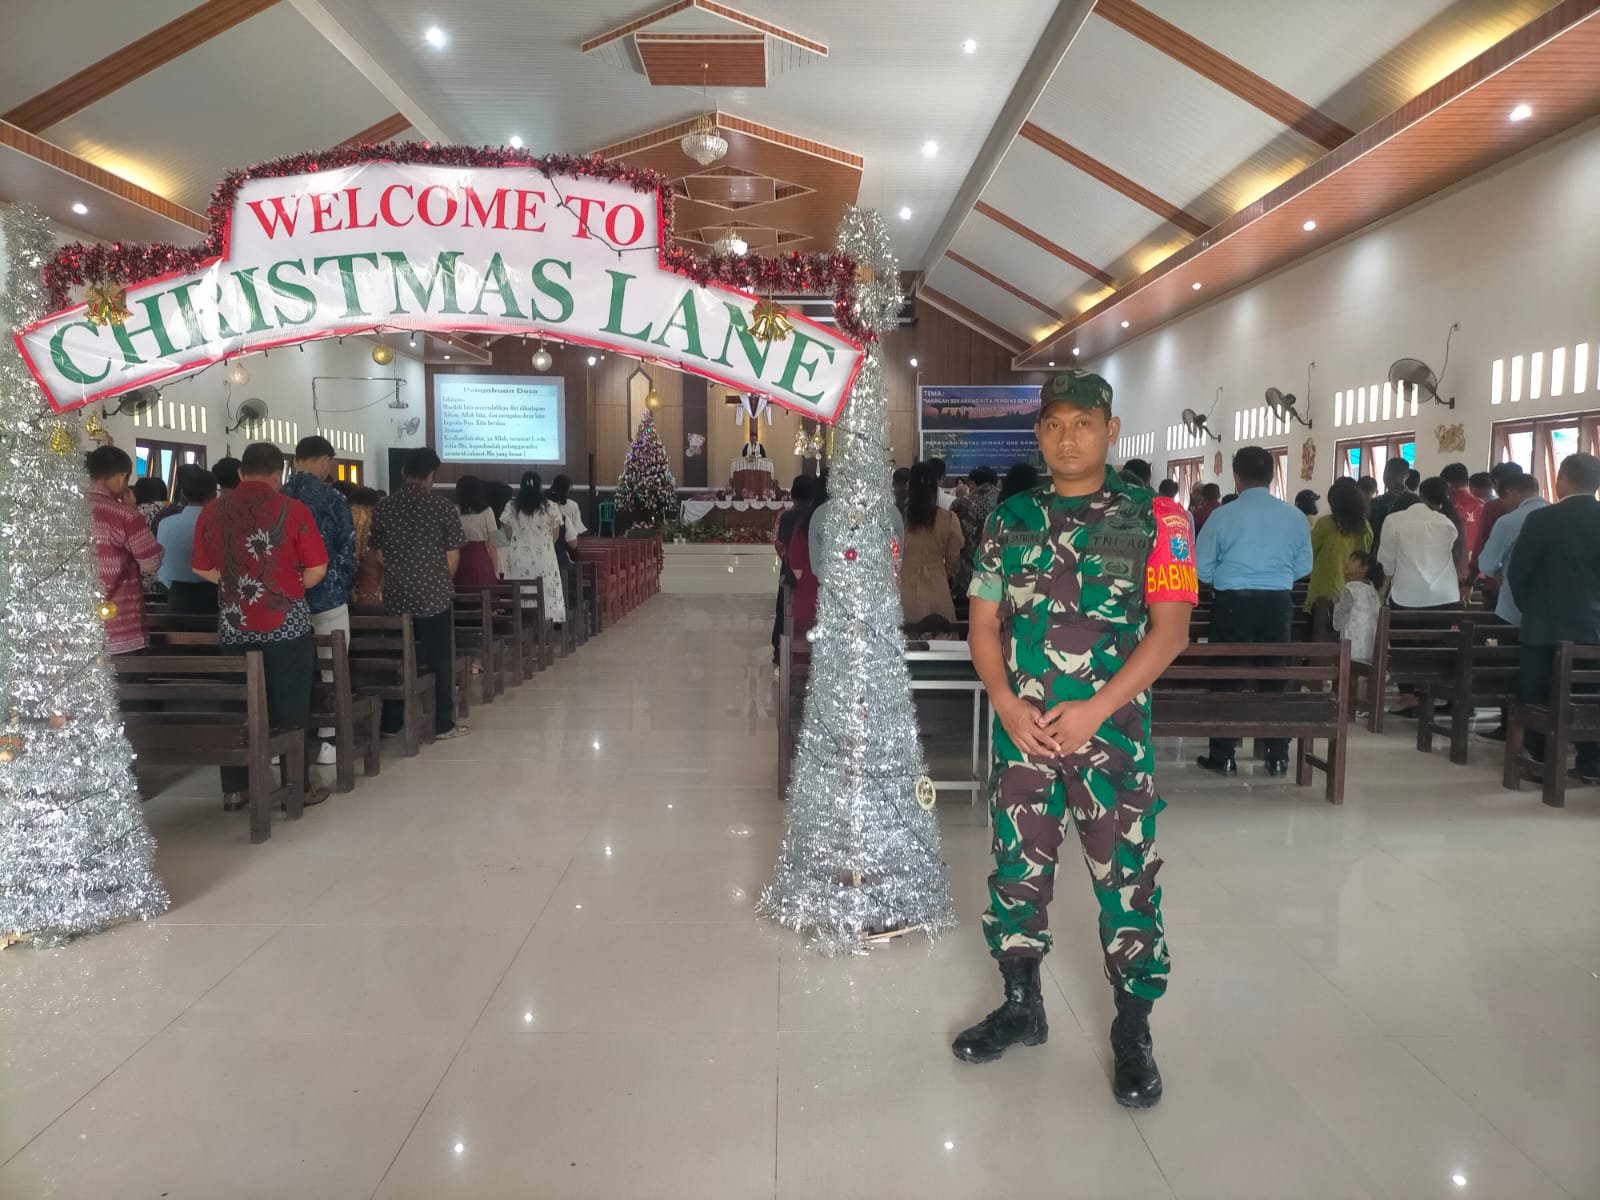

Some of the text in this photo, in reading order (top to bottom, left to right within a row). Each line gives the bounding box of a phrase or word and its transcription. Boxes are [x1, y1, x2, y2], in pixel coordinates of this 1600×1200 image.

[245, 183, 646, 247] WELCOME TO
[48, 250, 837, 406] CHRISTMAS LANE
